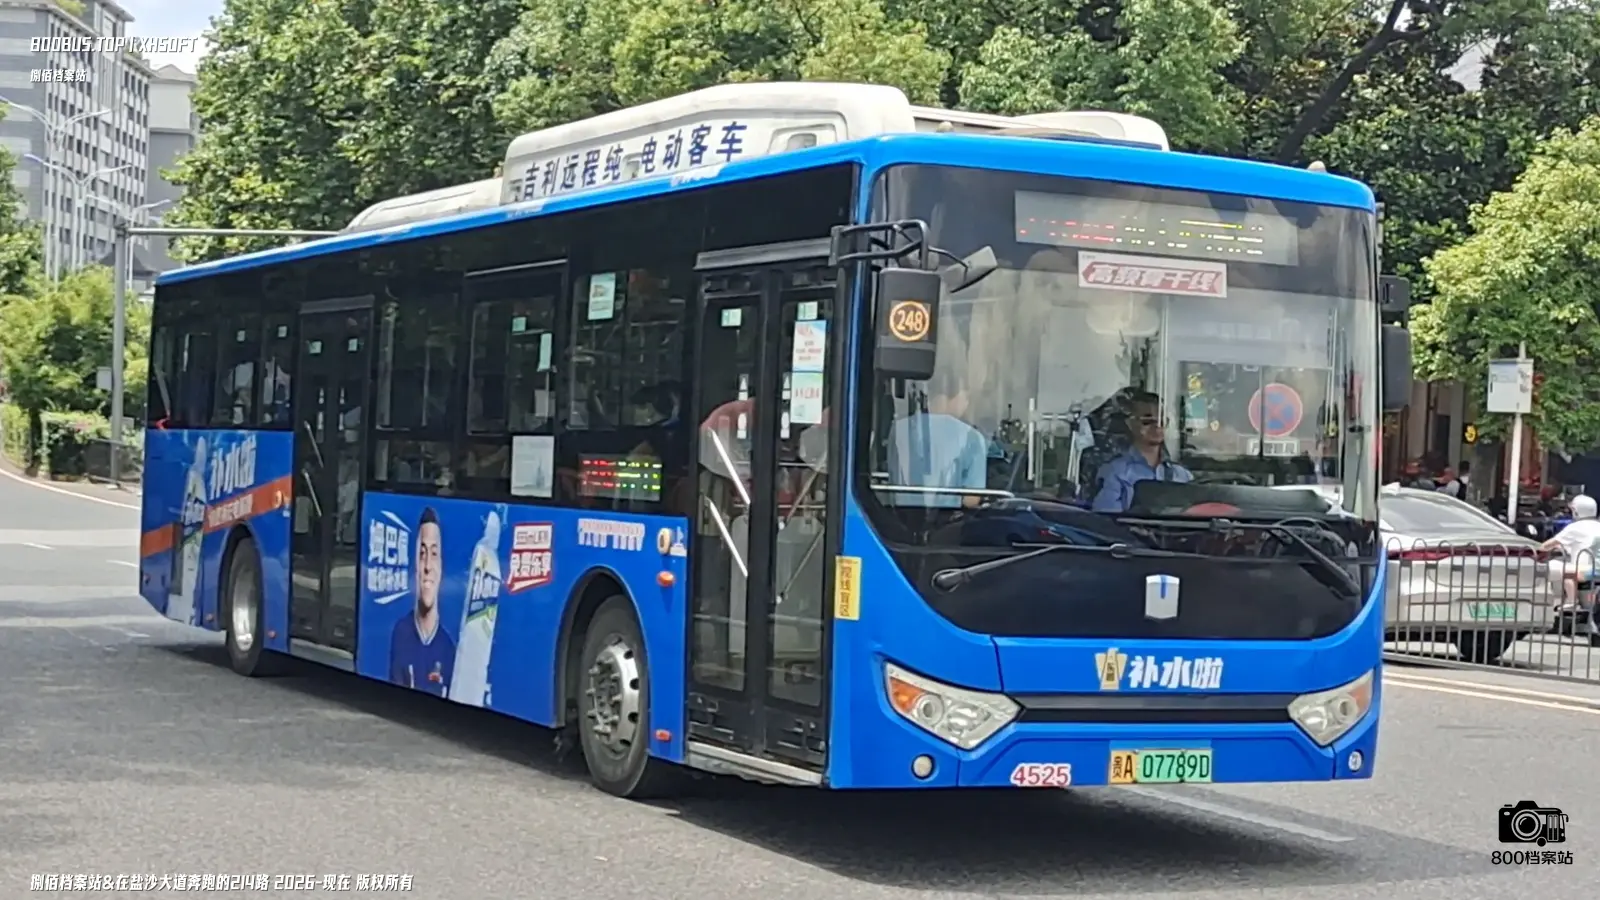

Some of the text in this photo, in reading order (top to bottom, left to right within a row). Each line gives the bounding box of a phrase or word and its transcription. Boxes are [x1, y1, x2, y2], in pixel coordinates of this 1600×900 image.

[896, 310, 924, 332] 248
[1128, 656, 1224, 689] 补水啦
[1011, 764, 1070, 786] 4525
[1142, 754, 1210, 779] 07789D
